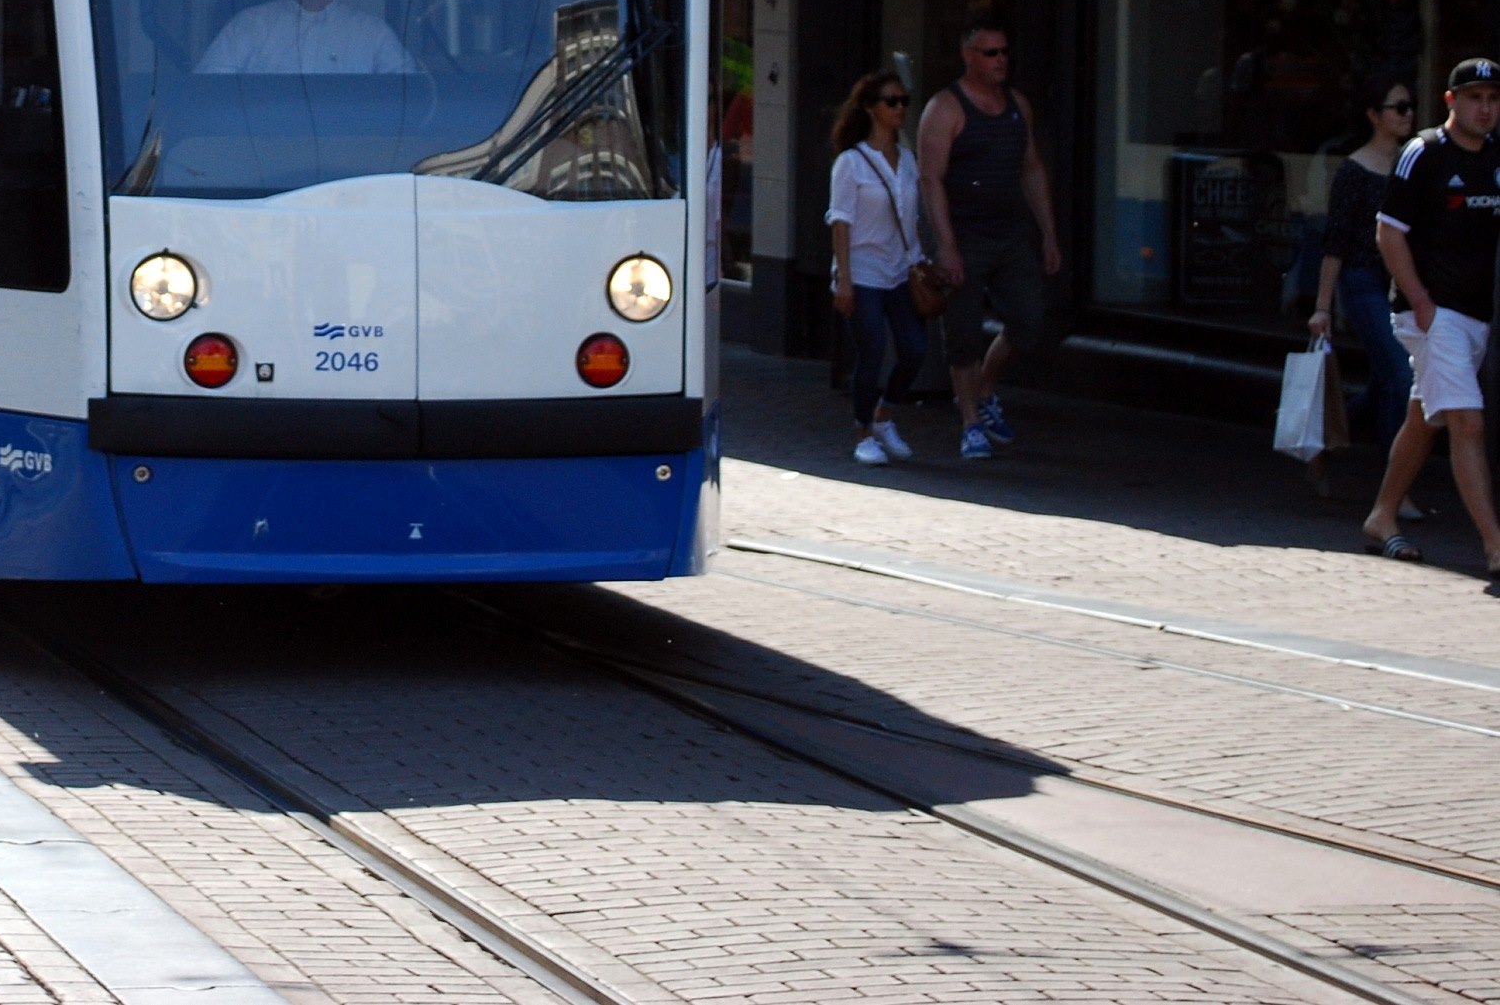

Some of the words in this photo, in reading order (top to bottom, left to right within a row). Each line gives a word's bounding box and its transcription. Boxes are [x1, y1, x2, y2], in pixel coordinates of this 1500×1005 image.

[348, 325, 384, 338] GVB
[315, 351, 379, 372] 2046
[24, 450, 53, 472] GVB
